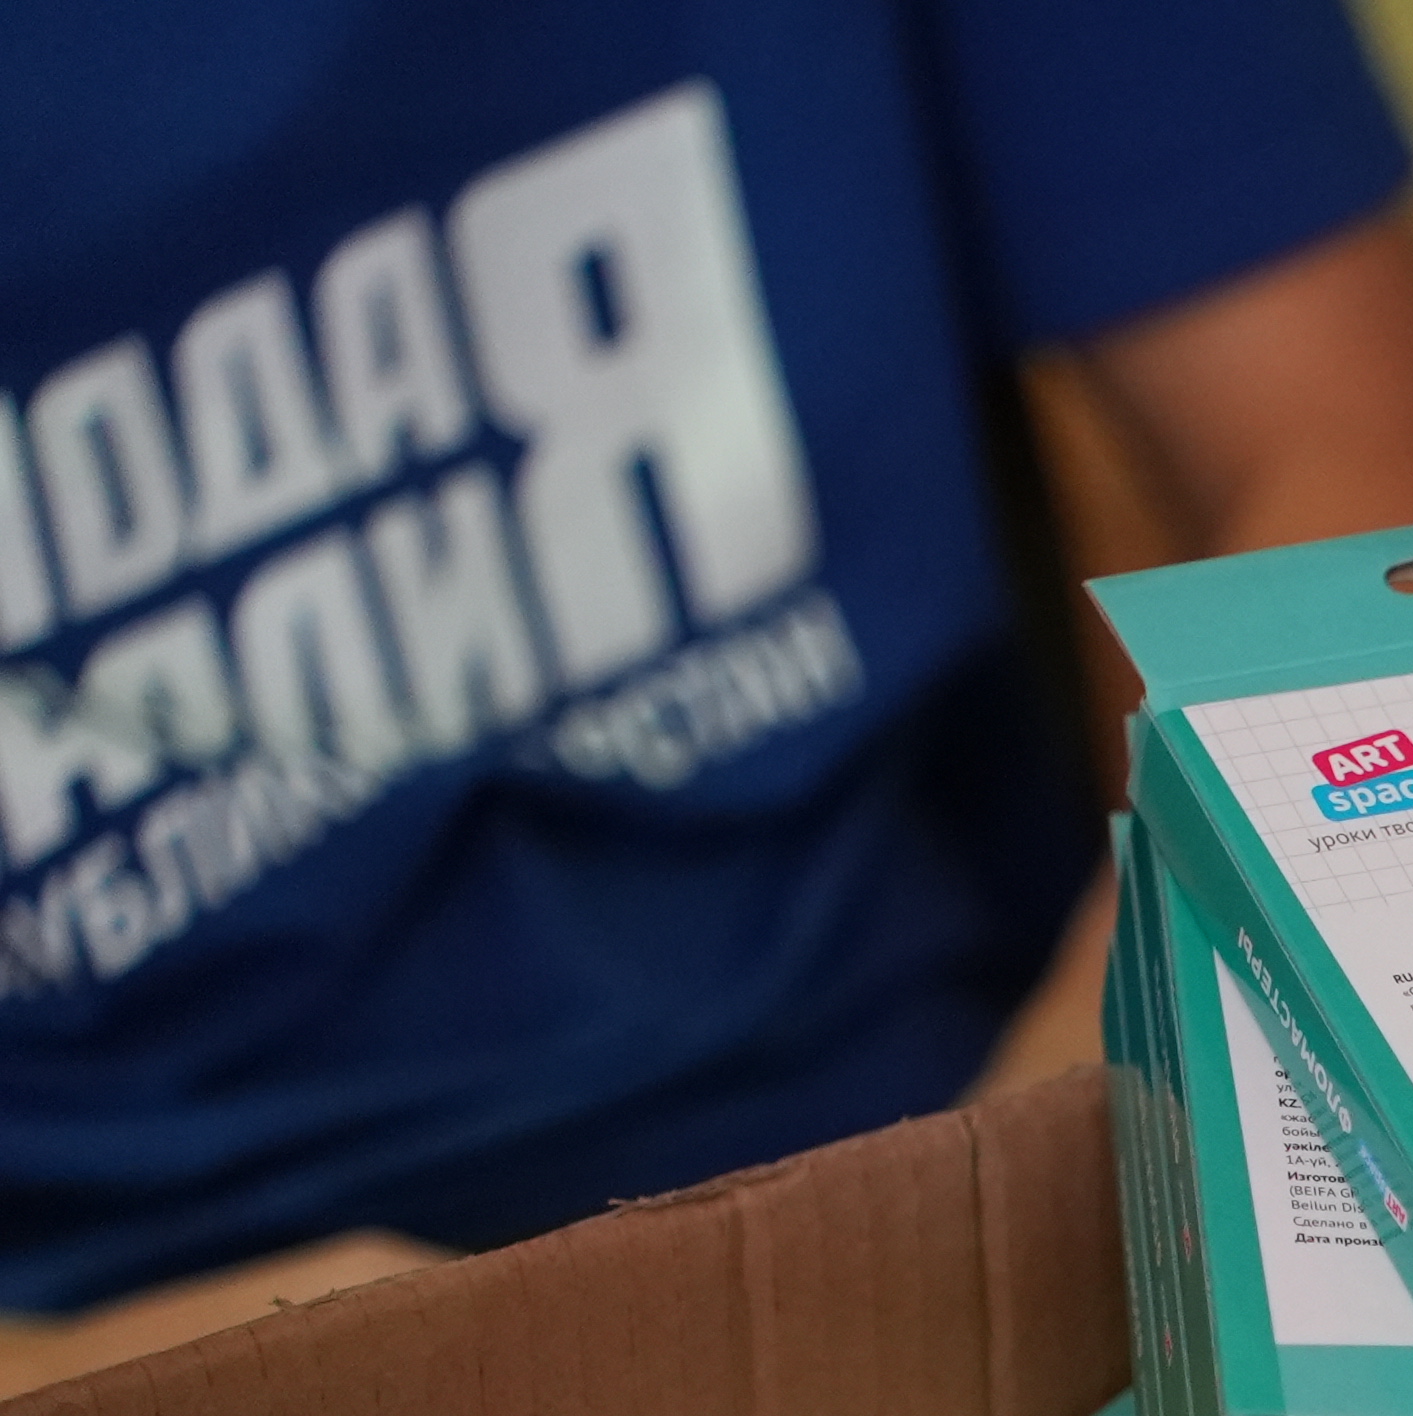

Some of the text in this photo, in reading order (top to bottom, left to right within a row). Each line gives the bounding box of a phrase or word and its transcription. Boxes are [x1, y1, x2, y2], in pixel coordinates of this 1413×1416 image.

[1328, 733, 1407, 782] ART
[1307, 826, 1377, 853] уроки
[1237, 926, 1353, 1134] ФЛОМАСТЕРЫ
[1290, 1198, 1339, 1213] Beilun
[1294, 1231, 1333, 1247] Дата
